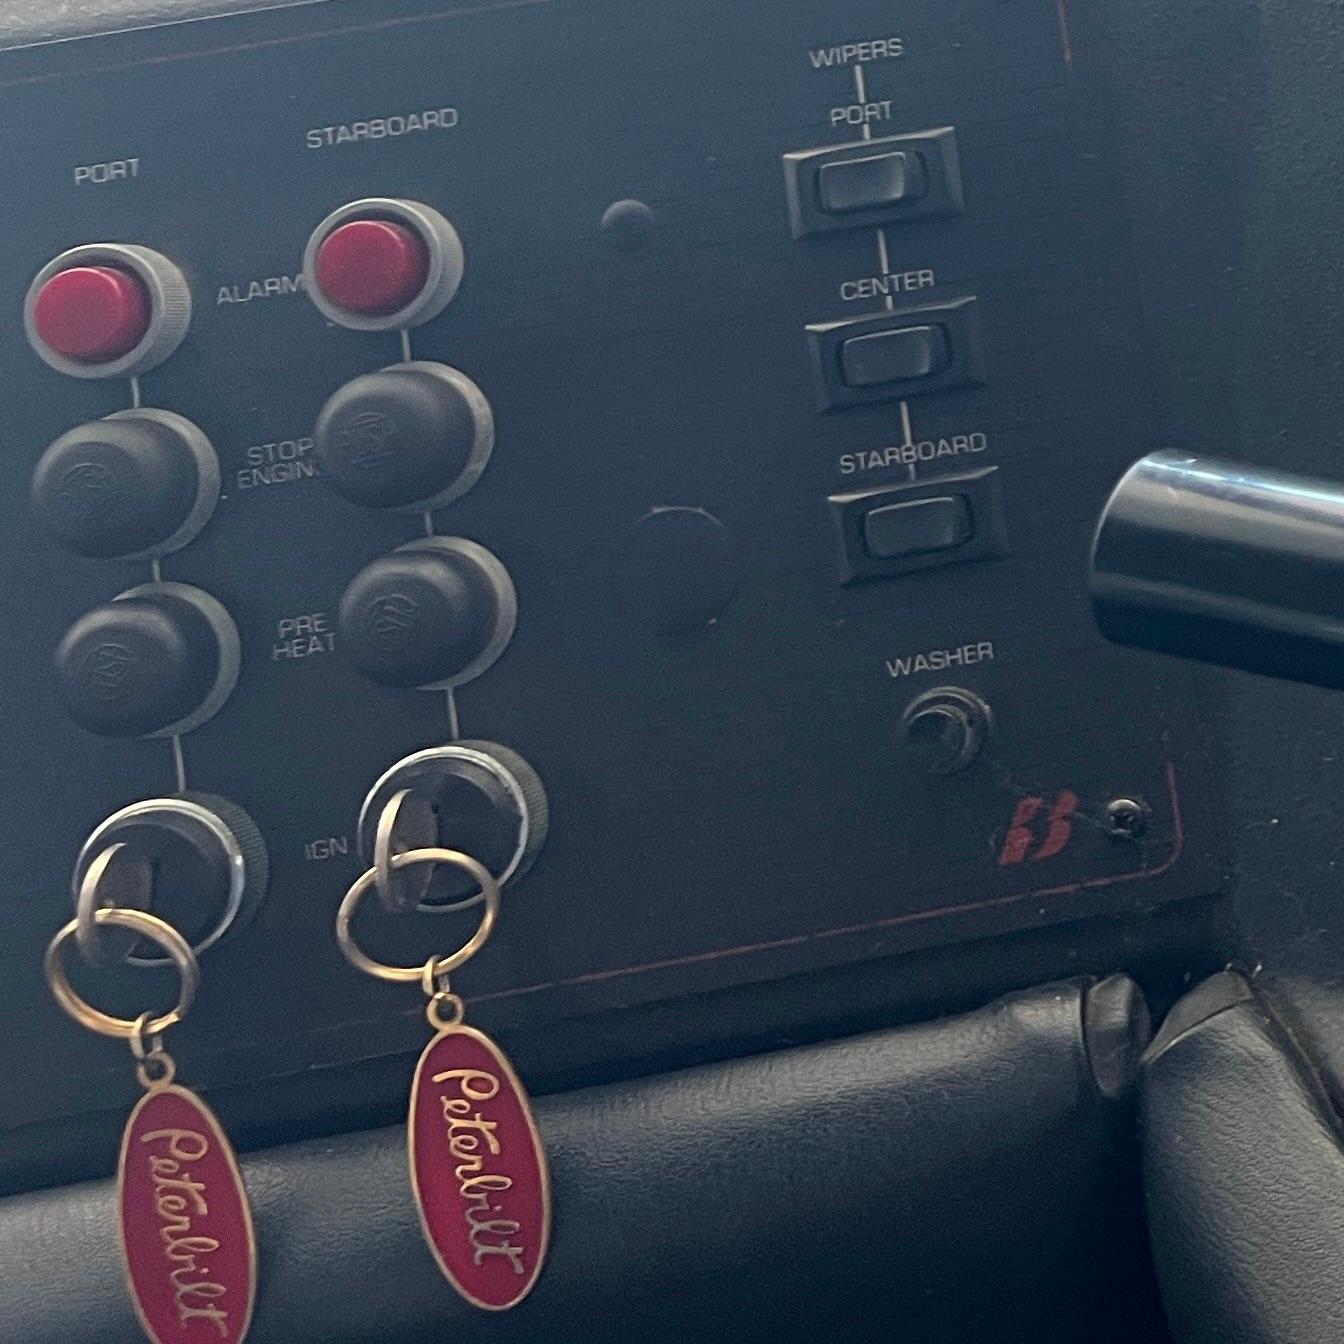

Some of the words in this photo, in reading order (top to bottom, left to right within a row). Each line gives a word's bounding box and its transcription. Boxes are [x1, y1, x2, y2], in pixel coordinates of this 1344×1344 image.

[808, 37, 904, 68] WIPERS
[306, 107, 459, 149] STARBOARD
[830, 100, 893, 126] PORT
[74, 158, 141, 186] PORT
[840, 269, 935, 301] CENTER
[247, 437, 314, 466] STOP
[839, 433, 987, 474] STARBOARD
[238, 461, 316, 489] ENGIN
[279, 613, 328, 635] PRE
[272, 632, 337, 661] HEAT
[886, 641, 995, 678] WASHER
[305, 836, 348, 860] IGN
[431, 1068, 524, 1275] Peterbilt
[142, 1129, 229, 1338] Peterbilt
